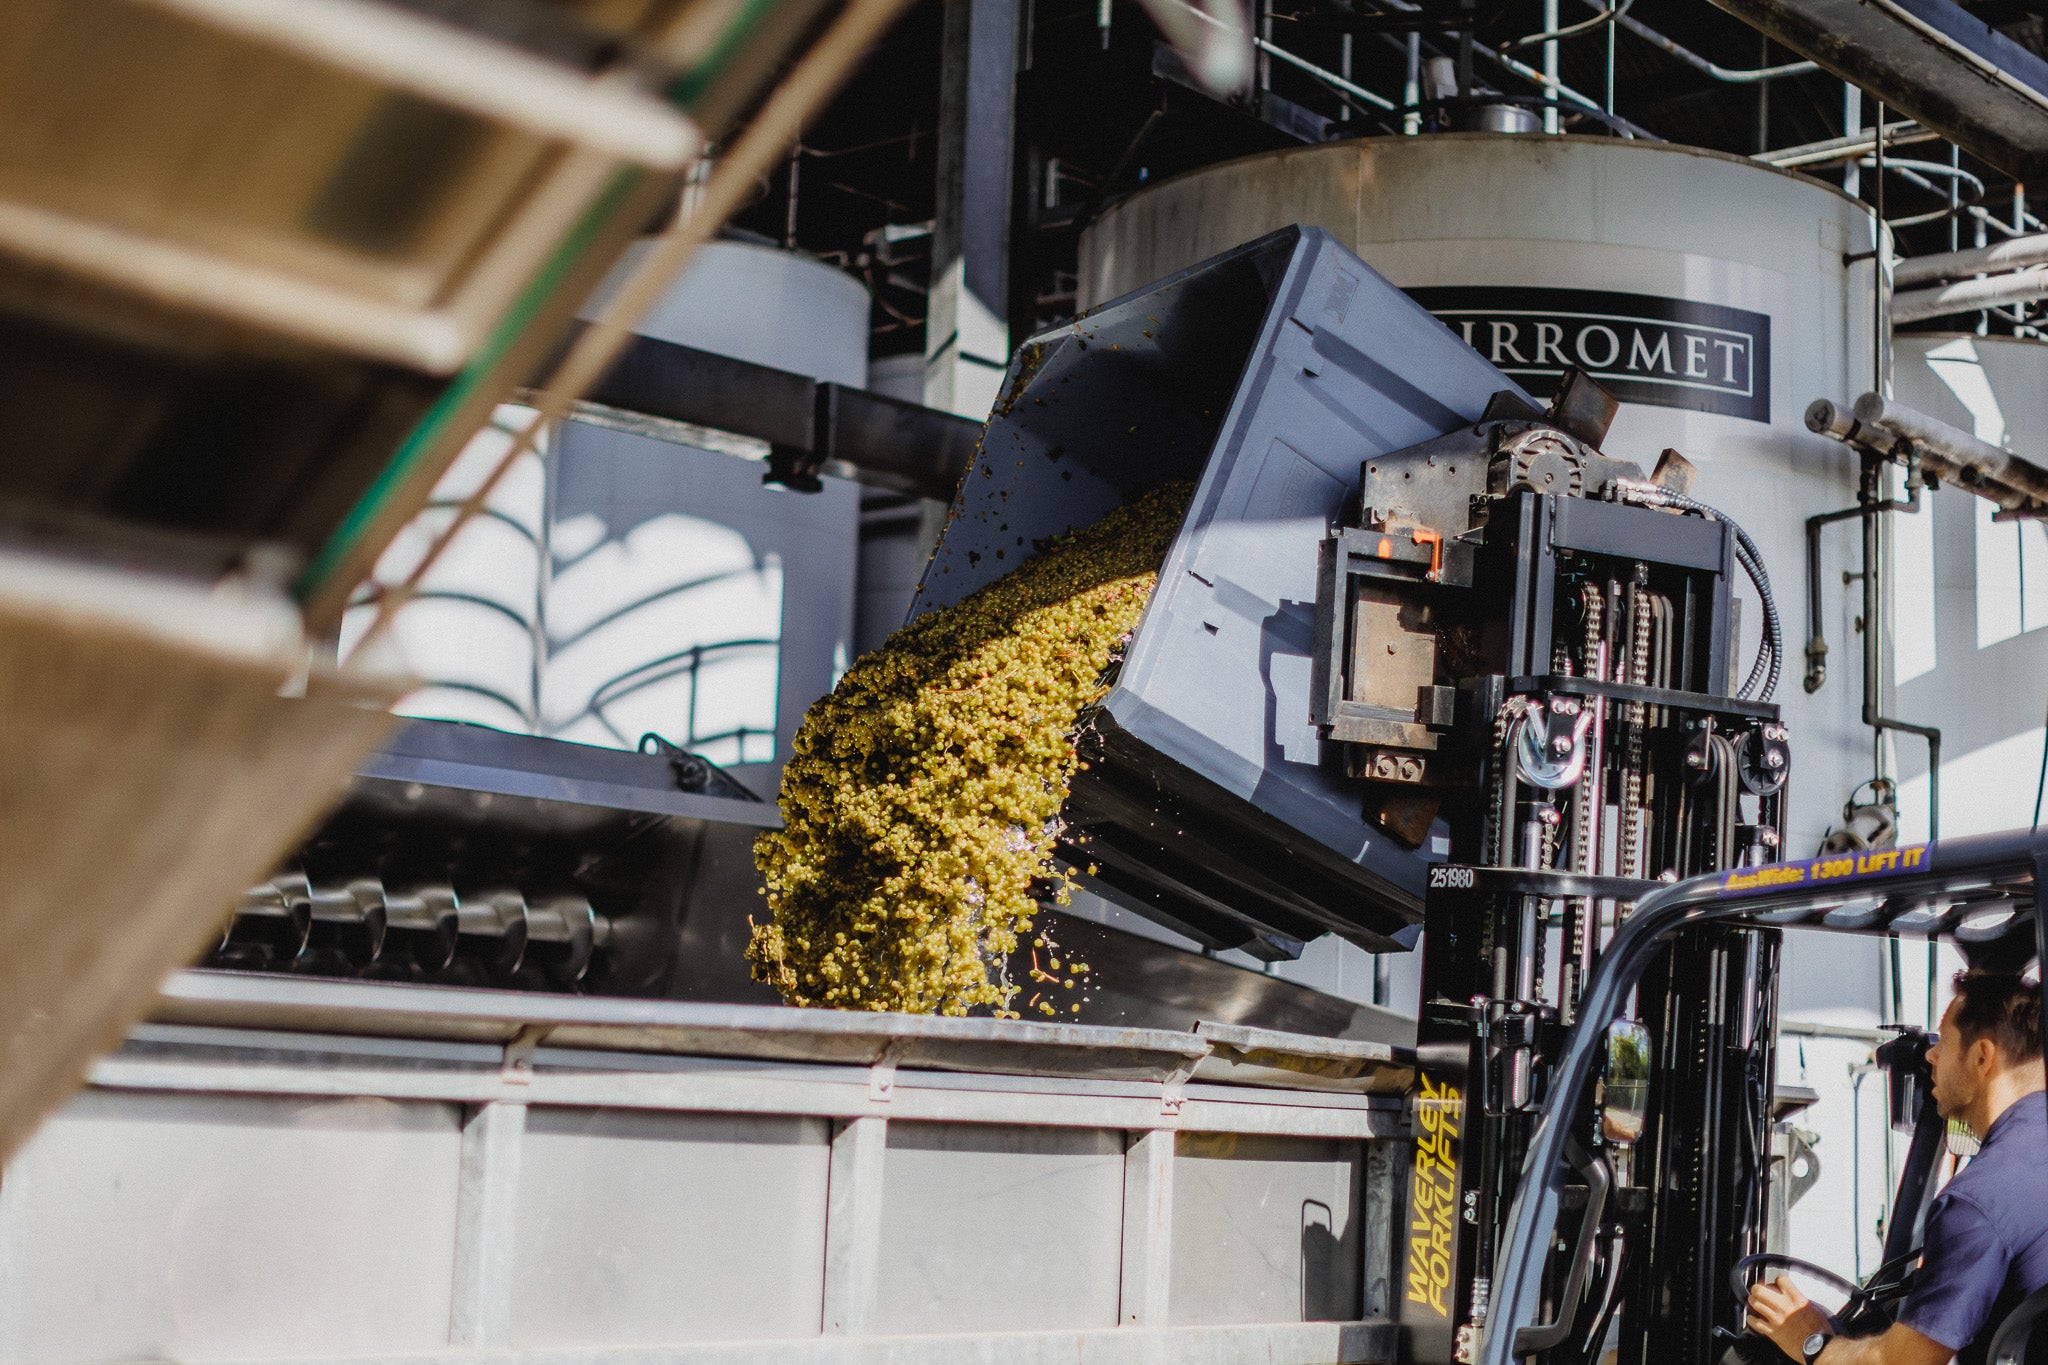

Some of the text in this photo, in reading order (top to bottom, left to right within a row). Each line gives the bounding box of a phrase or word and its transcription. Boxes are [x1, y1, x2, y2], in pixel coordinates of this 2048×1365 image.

[1440, 319, 1745, 383] IRROMET
[1430, 867, 1474, 888] 251980
[1811, 860, 1854, 880] 1300
[1857, 852, 1900, 874] LIFT
[1903, 847, 1926, 867] IT
[1408, 1072, 1439, 1304] WAVERLEY
[1429, 1081, 1461, 1318] FORKLIFTS
